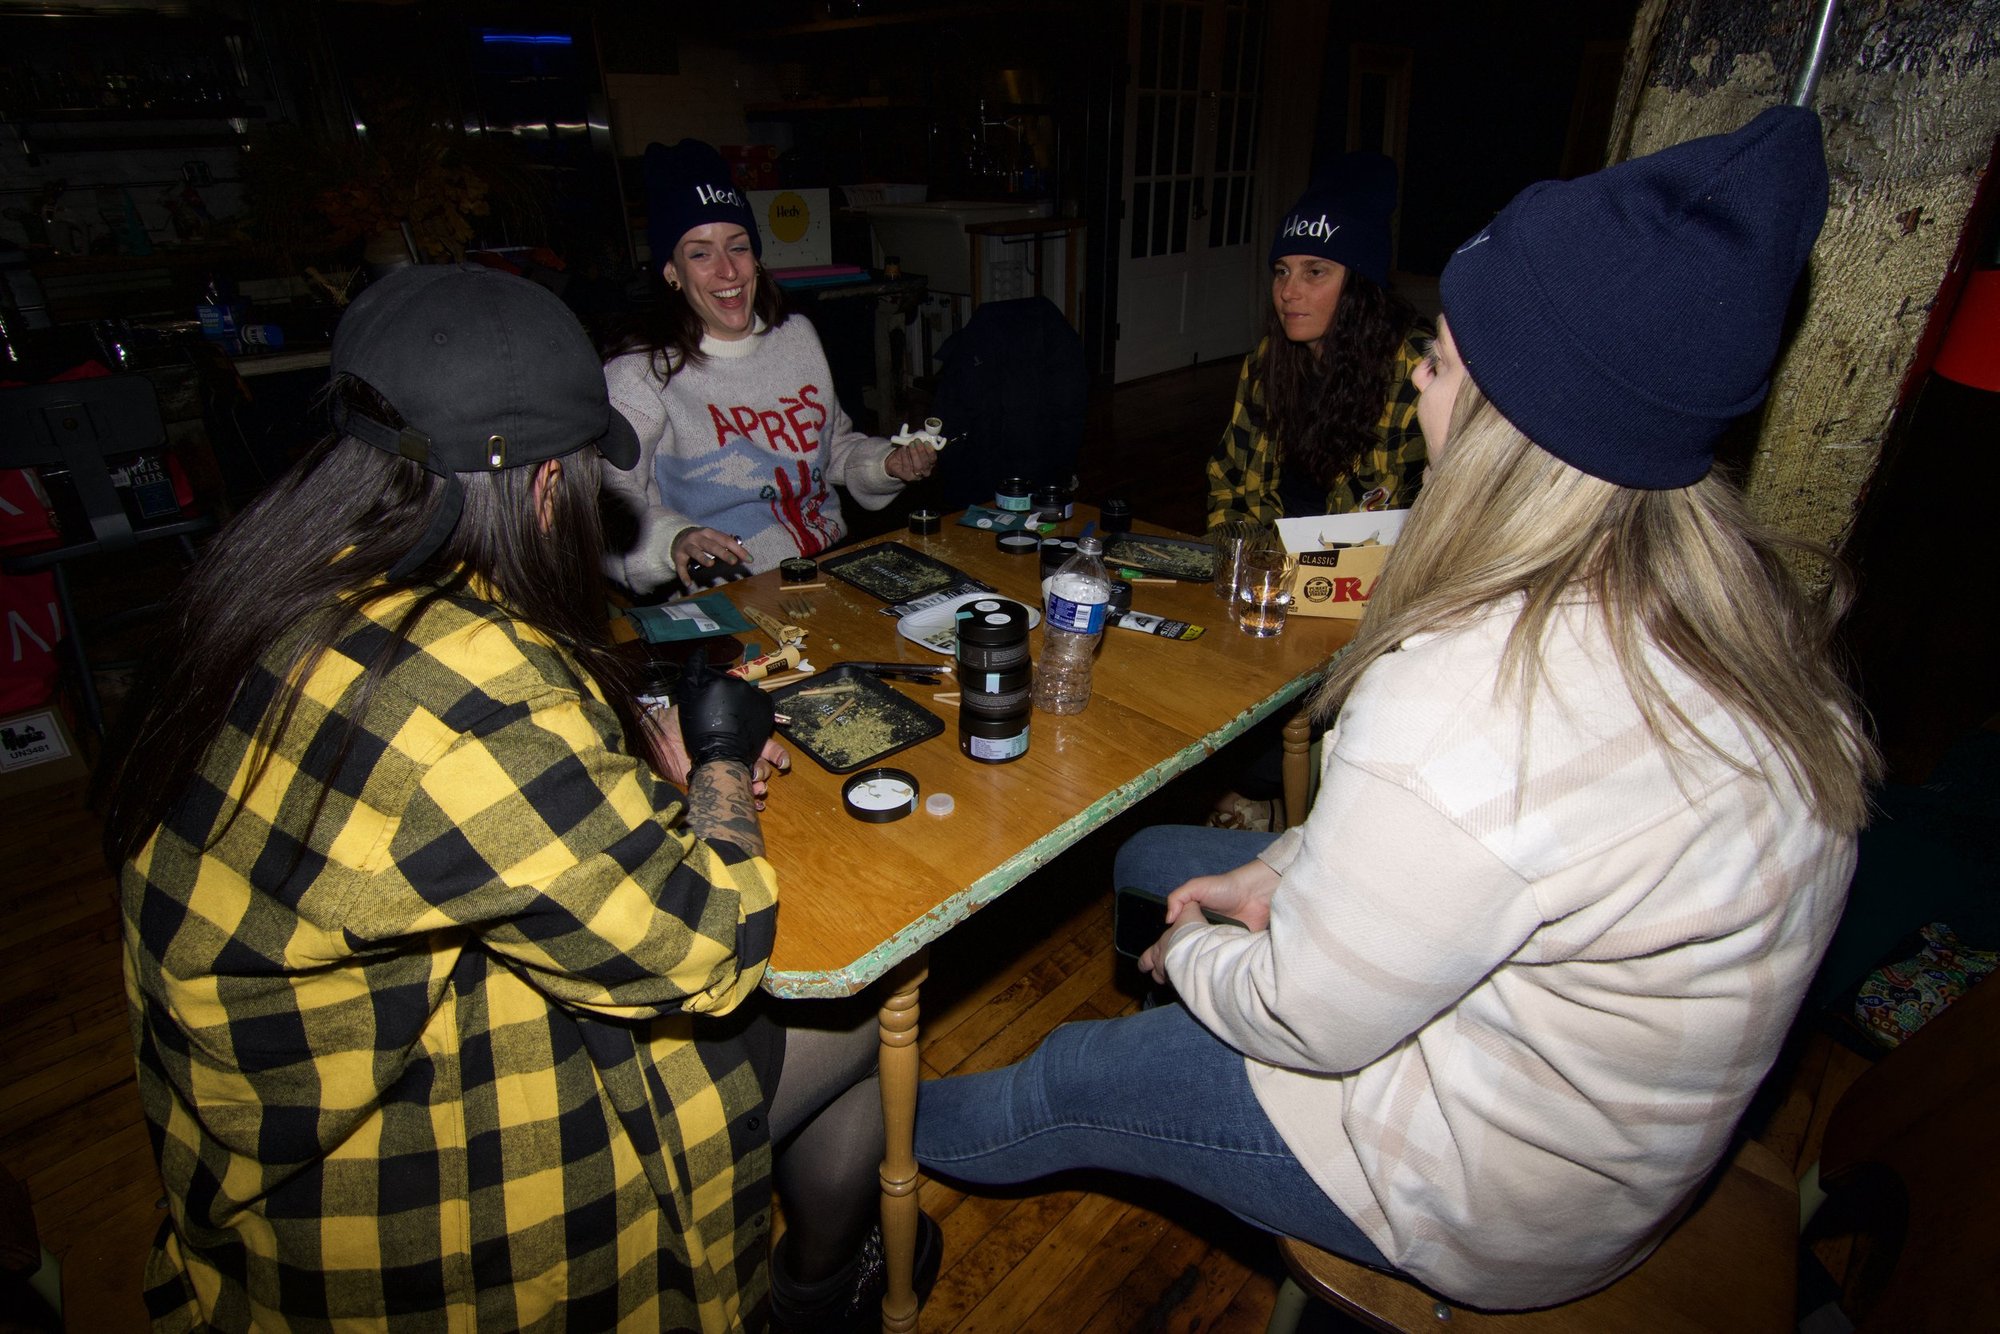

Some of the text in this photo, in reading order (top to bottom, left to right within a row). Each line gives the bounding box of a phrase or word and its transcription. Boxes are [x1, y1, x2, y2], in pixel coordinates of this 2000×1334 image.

[1282, 214, 1341, 244] Hedy
[708, 384, 826, 453] APRÈS
[1301, 554, 1336, 566] CLASSIC
[1871, 1016, 1898, 1033] OCB
